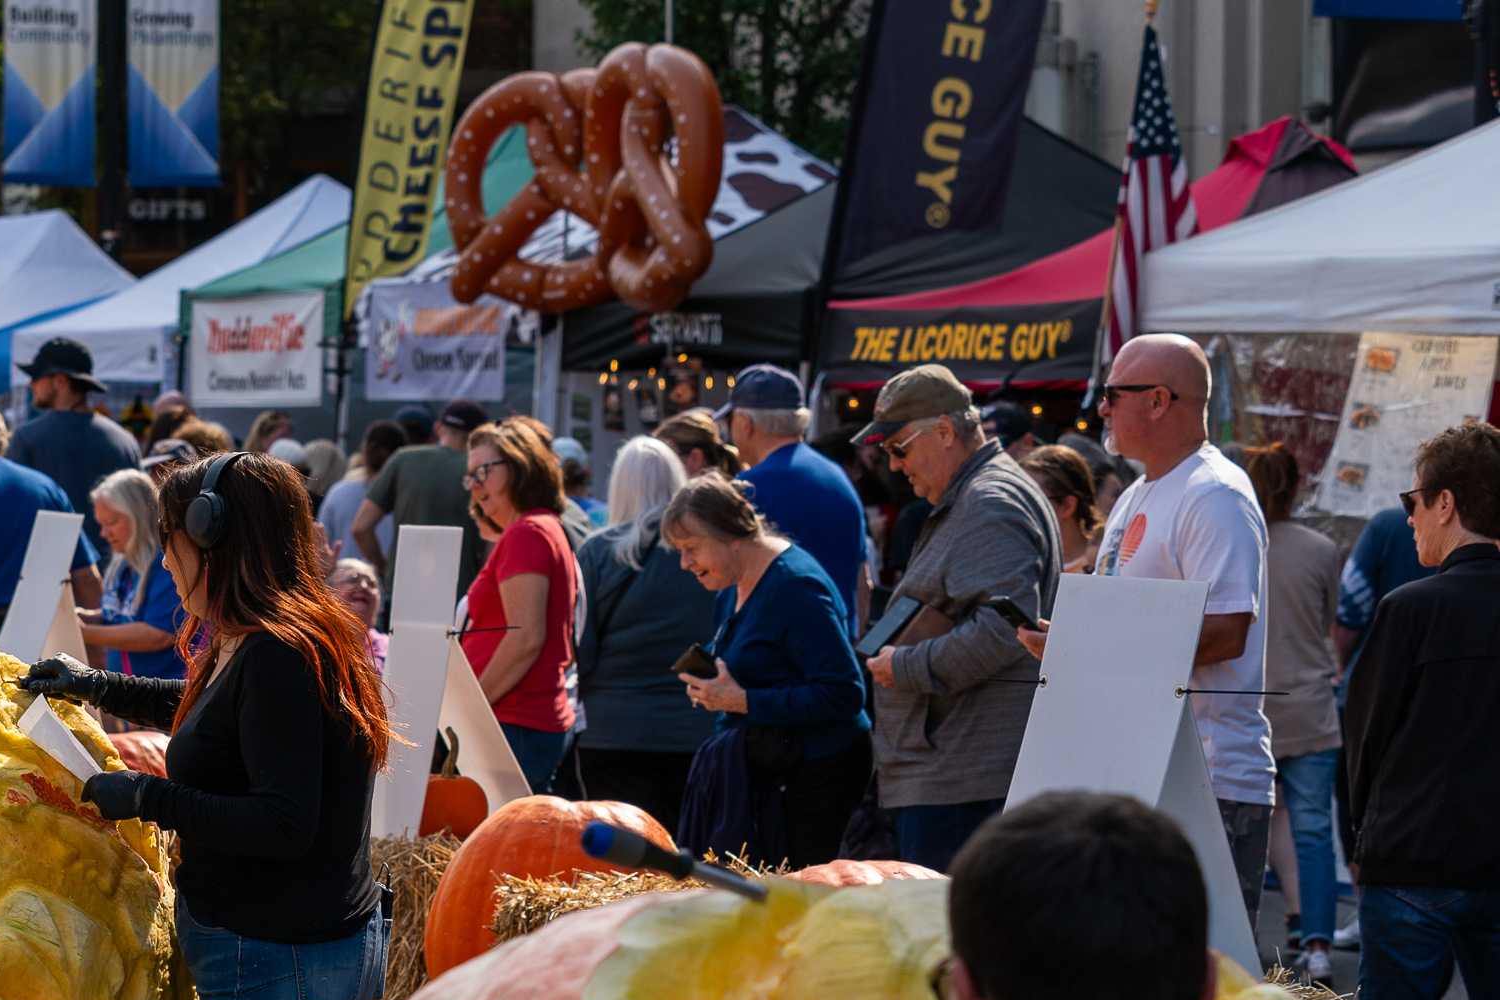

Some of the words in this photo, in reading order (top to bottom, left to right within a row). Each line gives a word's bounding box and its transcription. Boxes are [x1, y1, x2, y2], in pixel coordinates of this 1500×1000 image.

[10, 6, 78, 27] Building
[132, 10, 193, 29] Growing
[129, 200, 207, 220] GIFTS
[851, 326, 899, 362] THE
[898, 322, 1008, 362] LICORICE
